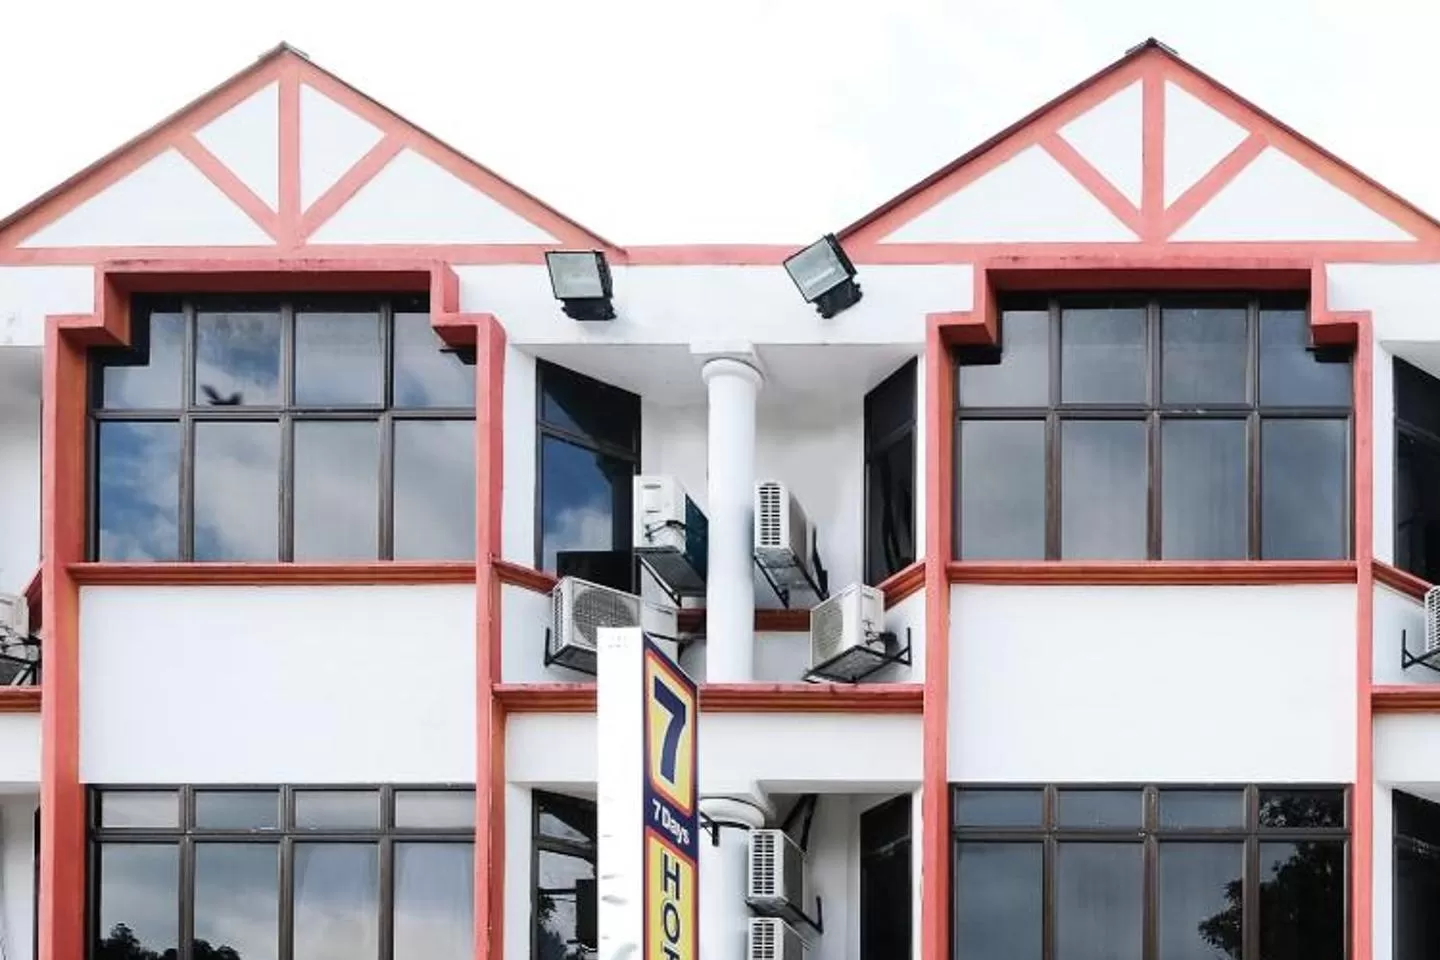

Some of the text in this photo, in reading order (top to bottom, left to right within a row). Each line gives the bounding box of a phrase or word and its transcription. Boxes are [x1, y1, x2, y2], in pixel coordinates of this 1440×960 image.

[654, 676, 686, 784] 7
[652, 798, 690, 845] 7 Days
